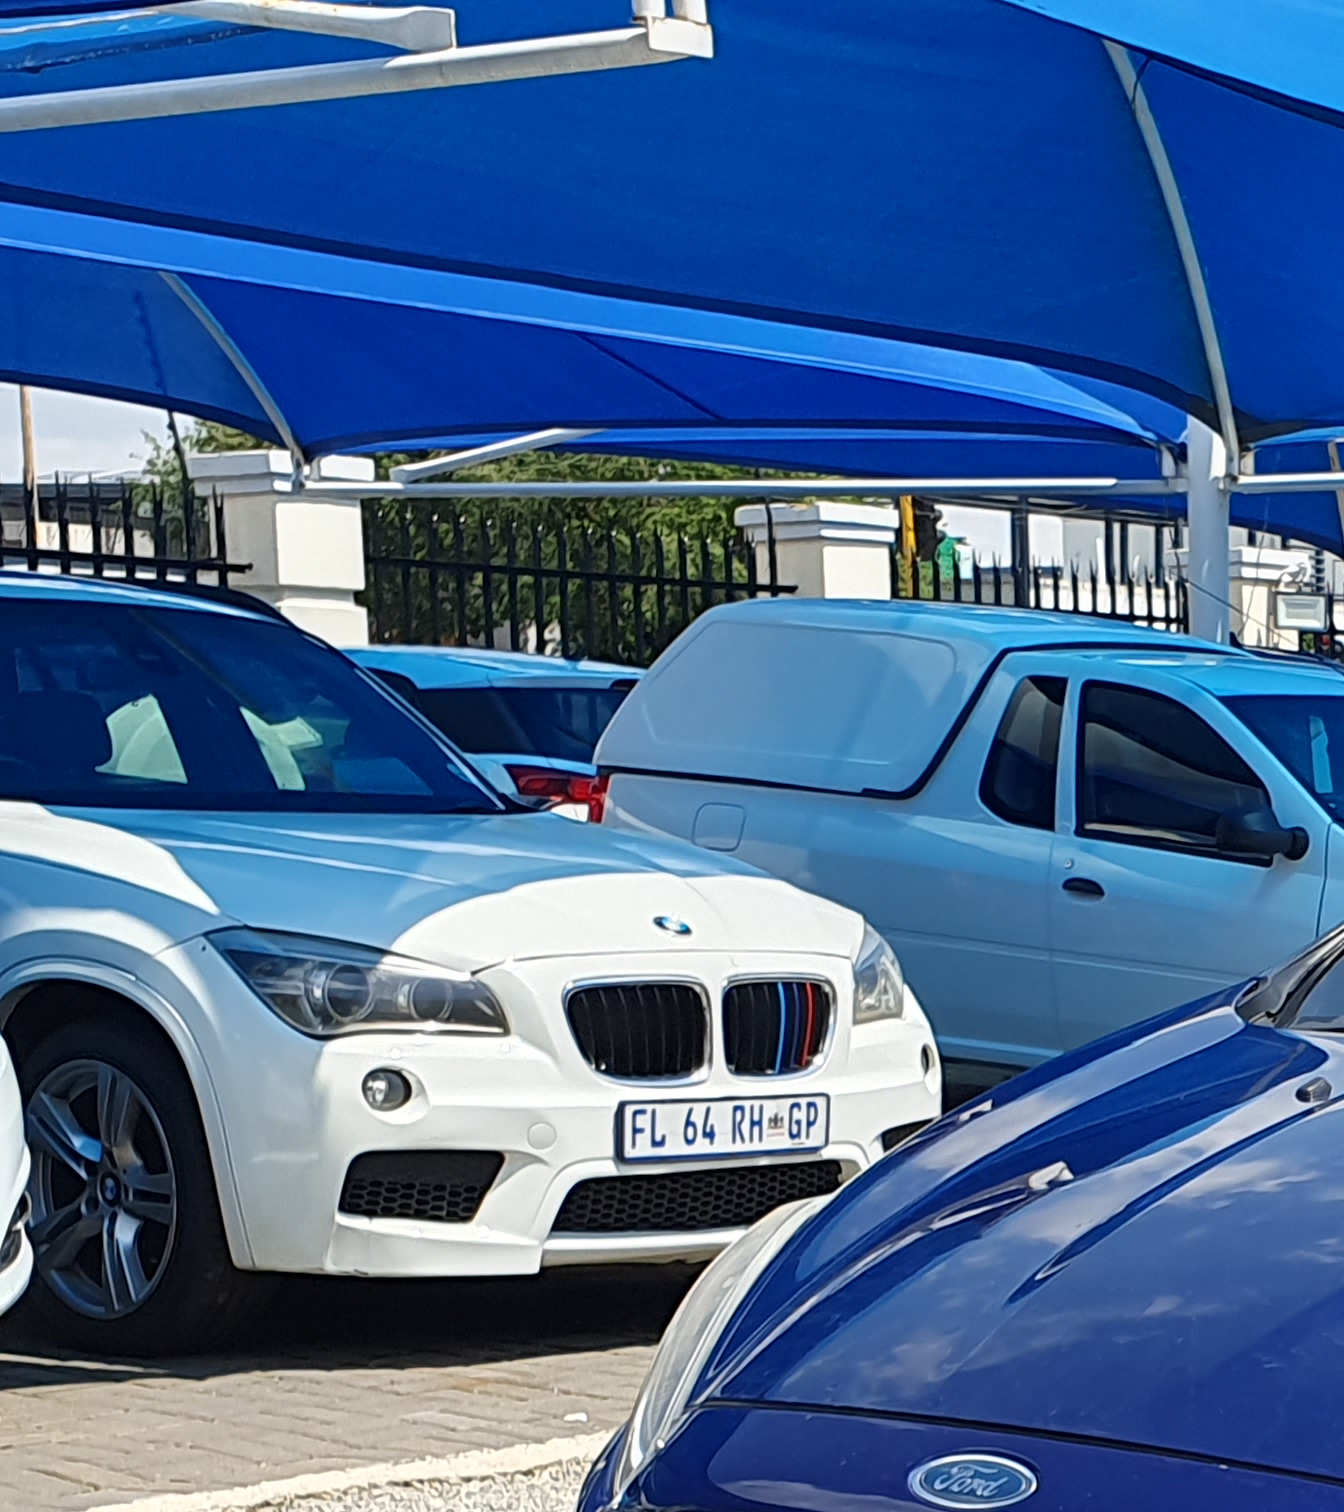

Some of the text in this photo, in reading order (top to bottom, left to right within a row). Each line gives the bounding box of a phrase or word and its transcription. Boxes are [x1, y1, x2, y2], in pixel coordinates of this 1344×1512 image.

[630, 1101, 819, 1150] FL 64 RH GP
[933, 1463, 1009, 1497] Ford
